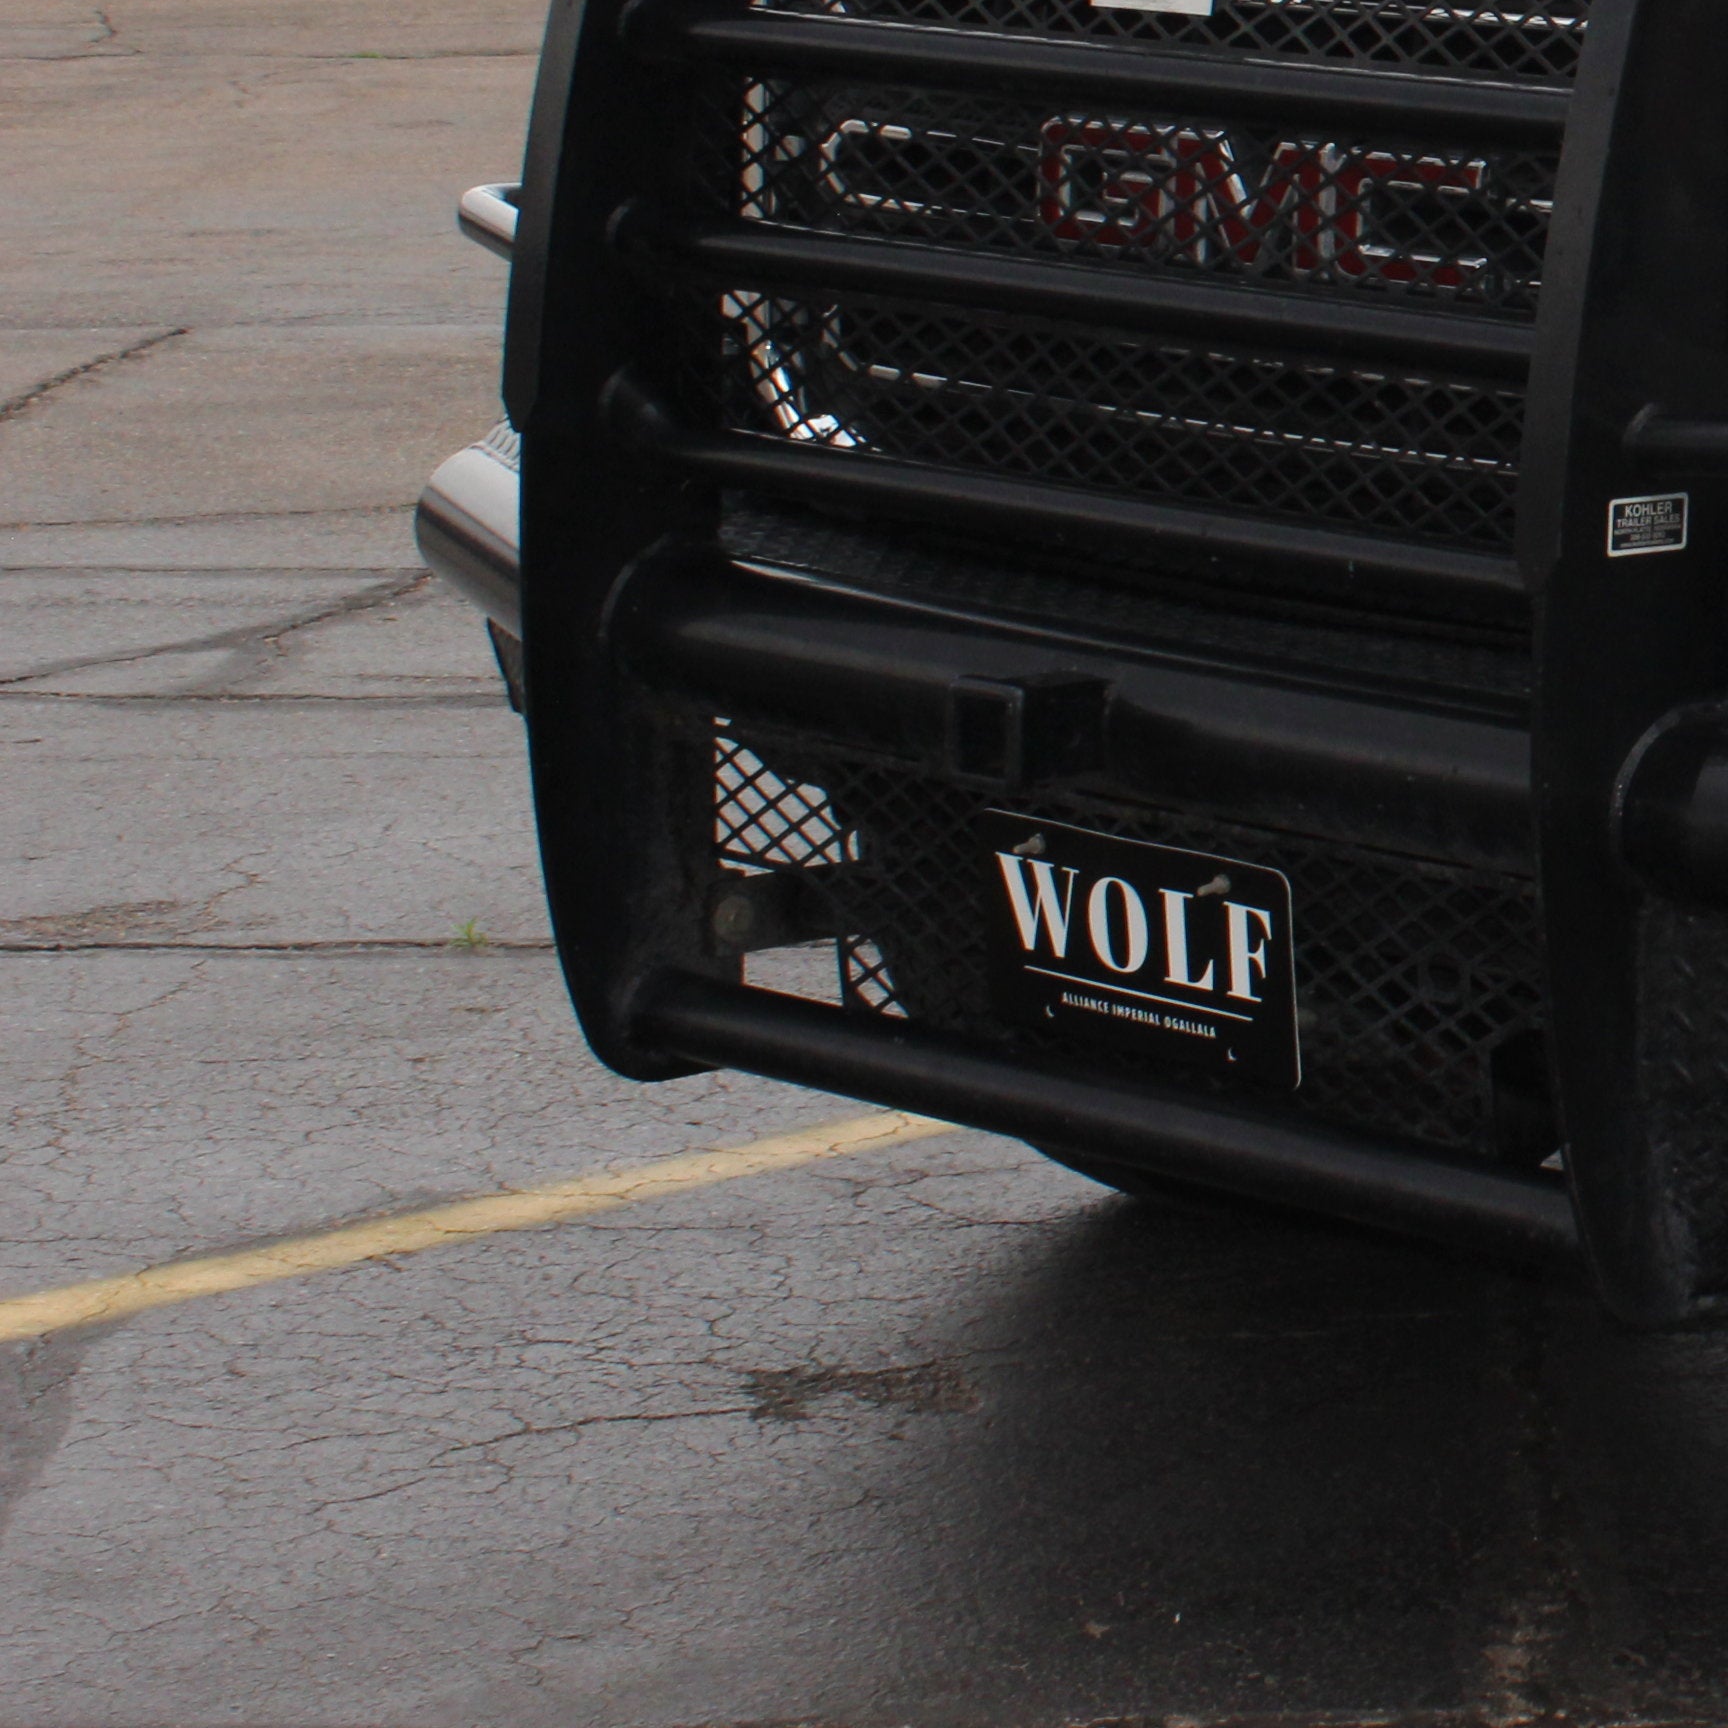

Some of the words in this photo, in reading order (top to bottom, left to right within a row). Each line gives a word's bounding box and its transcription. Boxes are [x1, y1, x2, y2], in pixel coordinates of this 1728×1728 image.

[1038, 114, 1489, 290] GMC
[1616, 516, 1653, 529] TRAILER
[1624, 500, 1673, 518] KOHLER
[995, 851, 1273, 1003] WOLF
[1062, 991, 1110, 1015] ALLIANCE
[1112, 1003, 1161, 1026] IMPERIAL
[1163, 1015, 1217, 1039] OGALLALA
